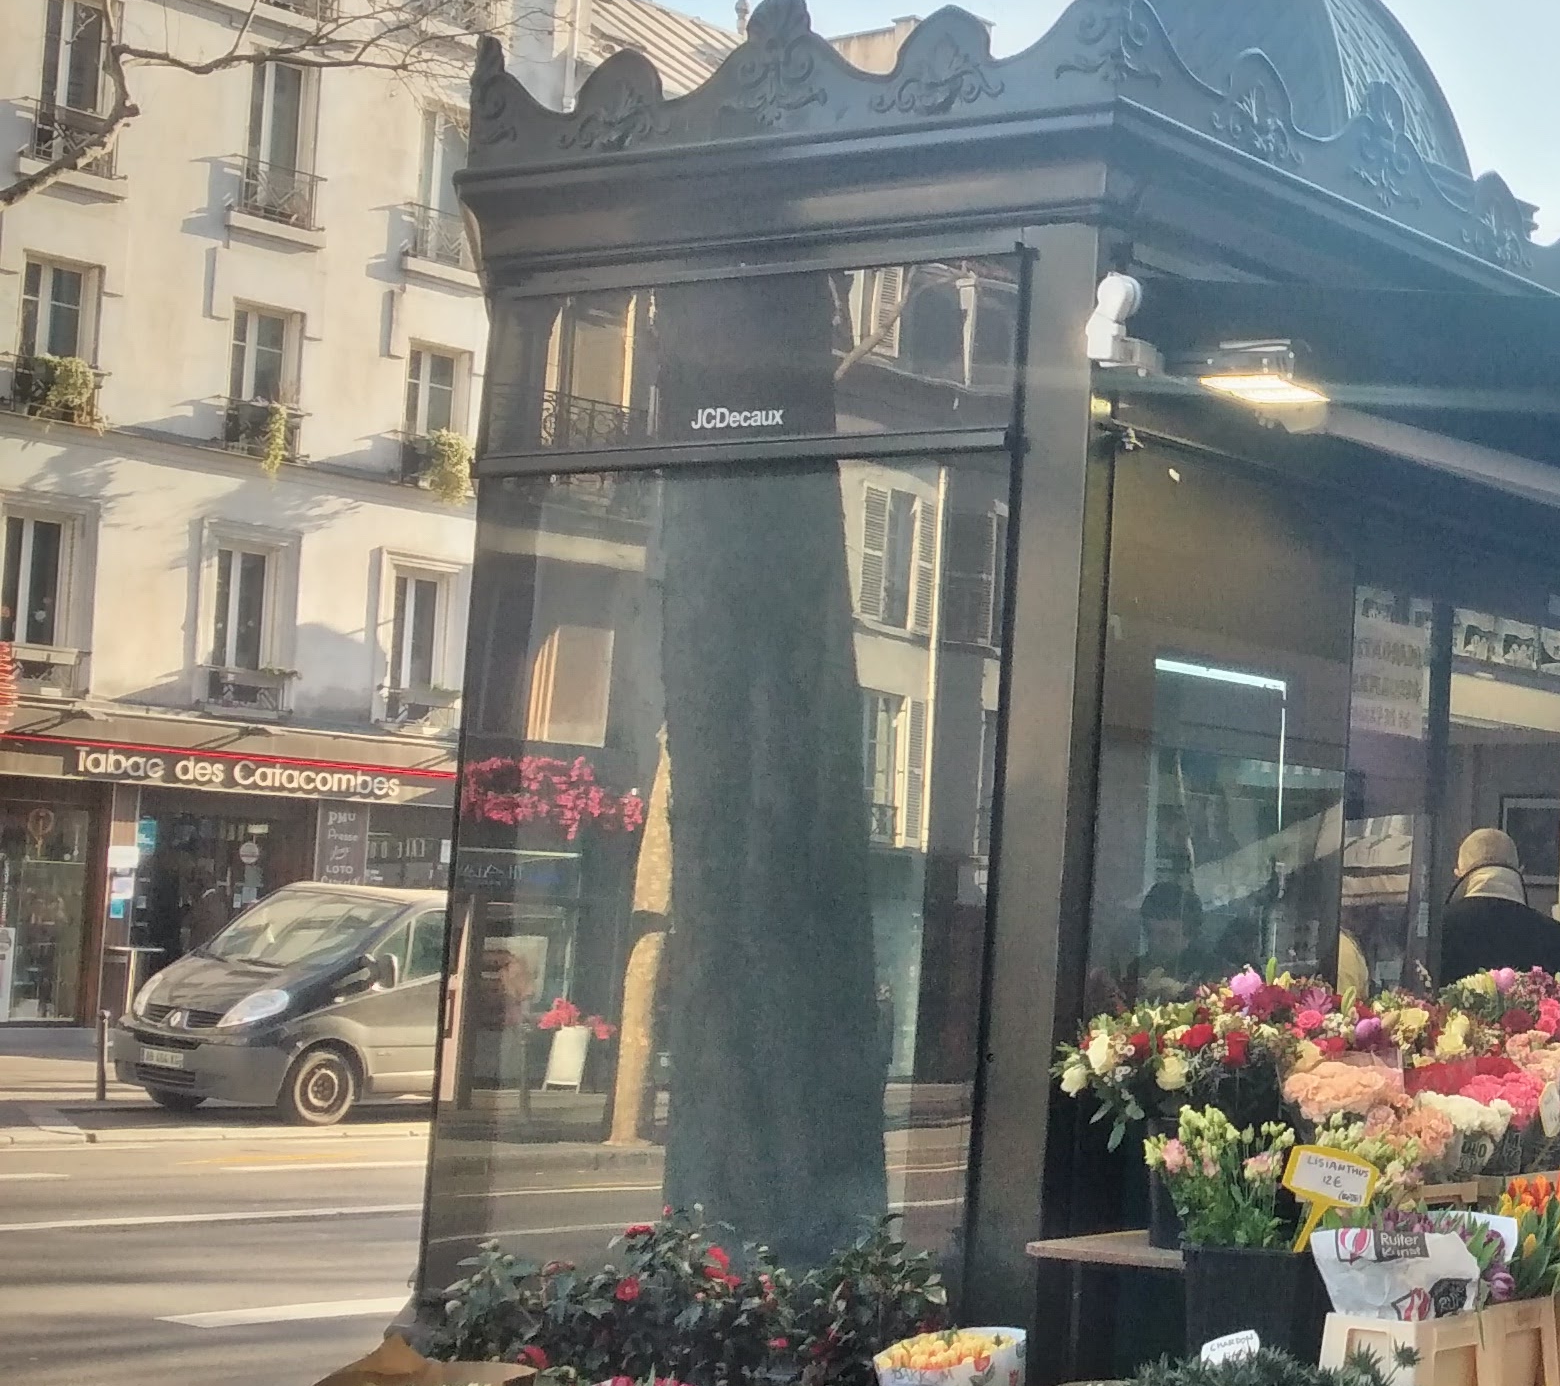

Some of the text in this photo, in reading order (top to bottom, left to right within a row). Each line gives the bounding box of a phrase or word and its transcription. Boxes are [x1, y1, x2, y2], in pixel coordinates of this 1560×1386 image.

[691, 408, 784, 430] JCDecaux
[74, 746, 401, 797] Tabac des Catacombes
[327, 811, 357, 826] PMU
[325, 864, 354, 875] LOTO
[1307, 1155, 1369, 1178] LISIANTHUS
[1322, 1174, 1343, 1188] 12€
[1380, 1232, 1419, 1247] Ruiter
[1210, 1332, 1254, 1352] CHARDON
